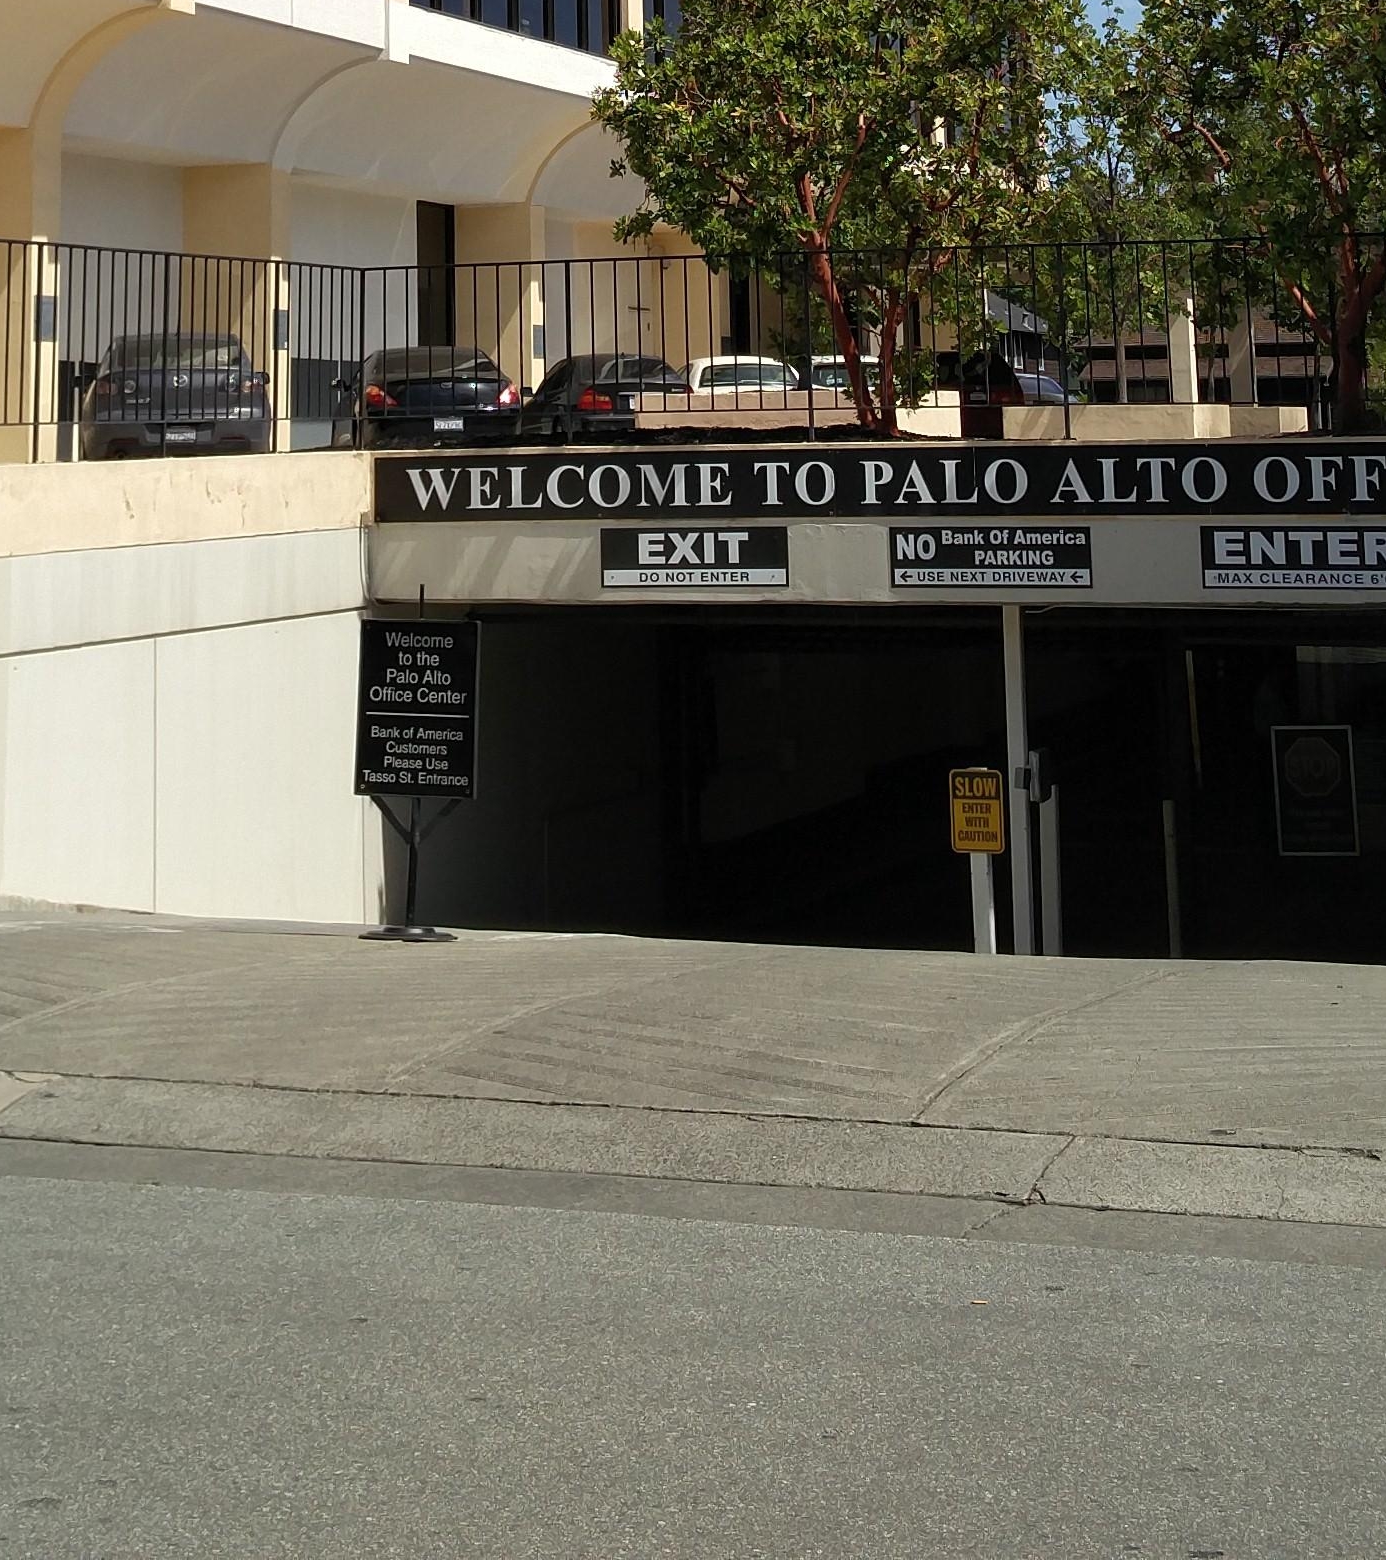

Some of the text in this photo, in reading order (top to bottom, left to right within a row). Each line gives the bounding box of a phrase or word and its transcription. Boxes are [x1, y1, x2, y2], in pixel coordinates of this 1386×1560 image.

[405, 462, 733, 511] WELCOME
[753, 461, 836, 505] TO
[859, 458, 1029, 504] PALO
[1049, 456, 1228, 503] ALTO
[941, 529, 1086, 545] Bank Of America
[638, 532, 749, 564] EXIT
[896, 533, 936, 560] NO
[974, 550, 1054, 565] PARKING
[639, 571, 750, 583] DO NOT ENTER
[917, 571, 1066, 582] USE NEXT DRIVEWAY
[1217, 573, 1253, 584] MAX
[1259, 573, 1364, 585] CLEARANCE
[385, 631, 454, 649] Welcome
[398, 651, 440, 666] to the
[386, 668, 452, 685] Palo Alto
[369, 686, 467, 704] Office Center
[370, 725, 464, 741] Bank of America
[386, 741, 448, 755] Customers
[383, 755, 449, 770] Please Use
[363, 769, 469, 786] Tasso St. Entrance
[954, 776, 997, 797] SLOW
[962, 802, 991, 814] ENTER
[965, 816, 990, 828] WITH
[957, 830, 998, 843] CAUTION
